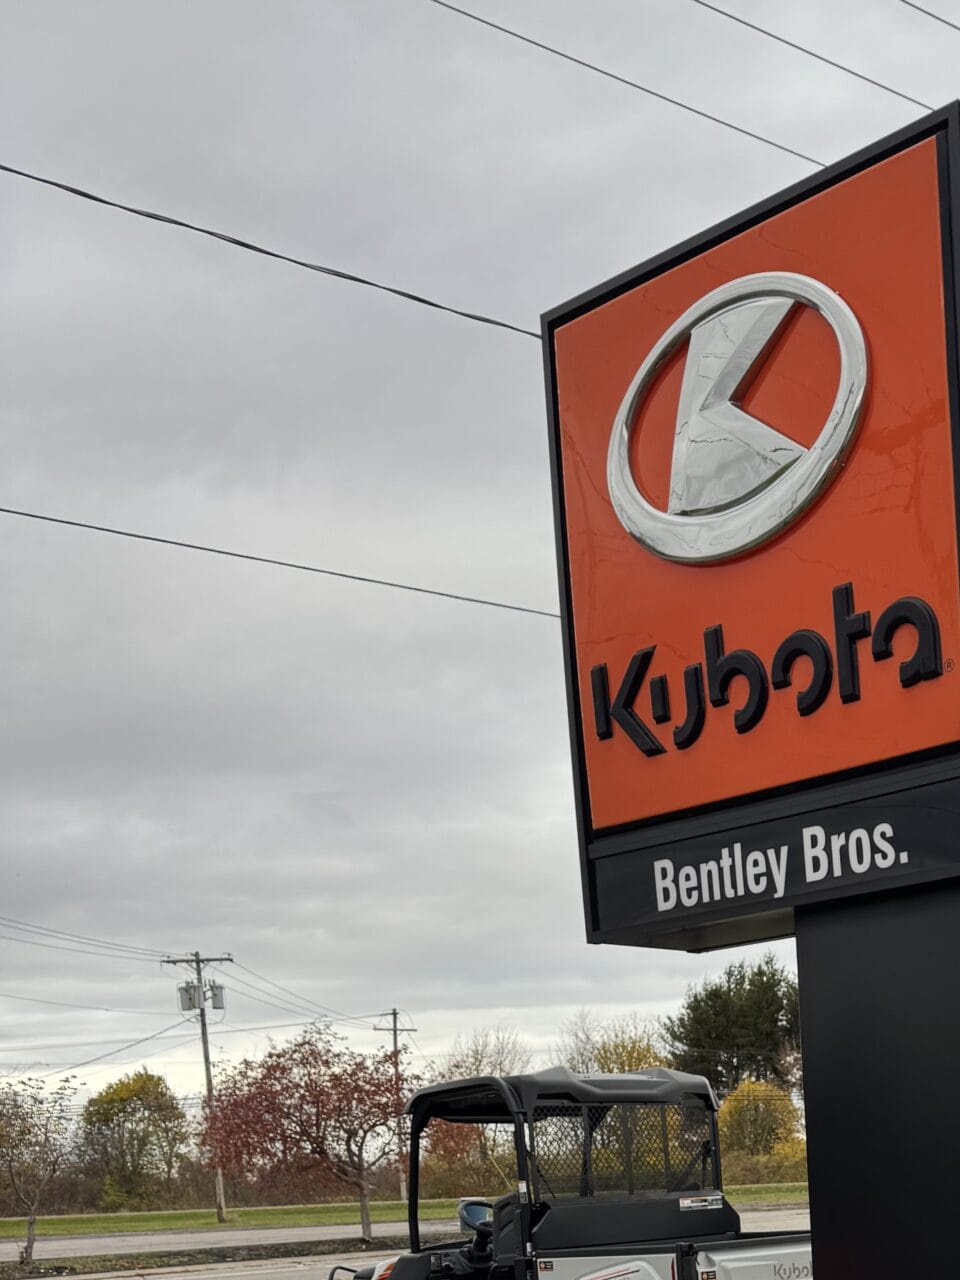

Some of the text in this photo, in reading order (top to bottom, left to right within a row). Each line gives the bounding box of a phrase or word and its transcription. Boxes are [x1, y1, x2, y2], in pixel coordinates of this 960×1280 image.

[590, 581, 945, 758] Kubota
[652, 822, 910, 913] Bentley Bros.
